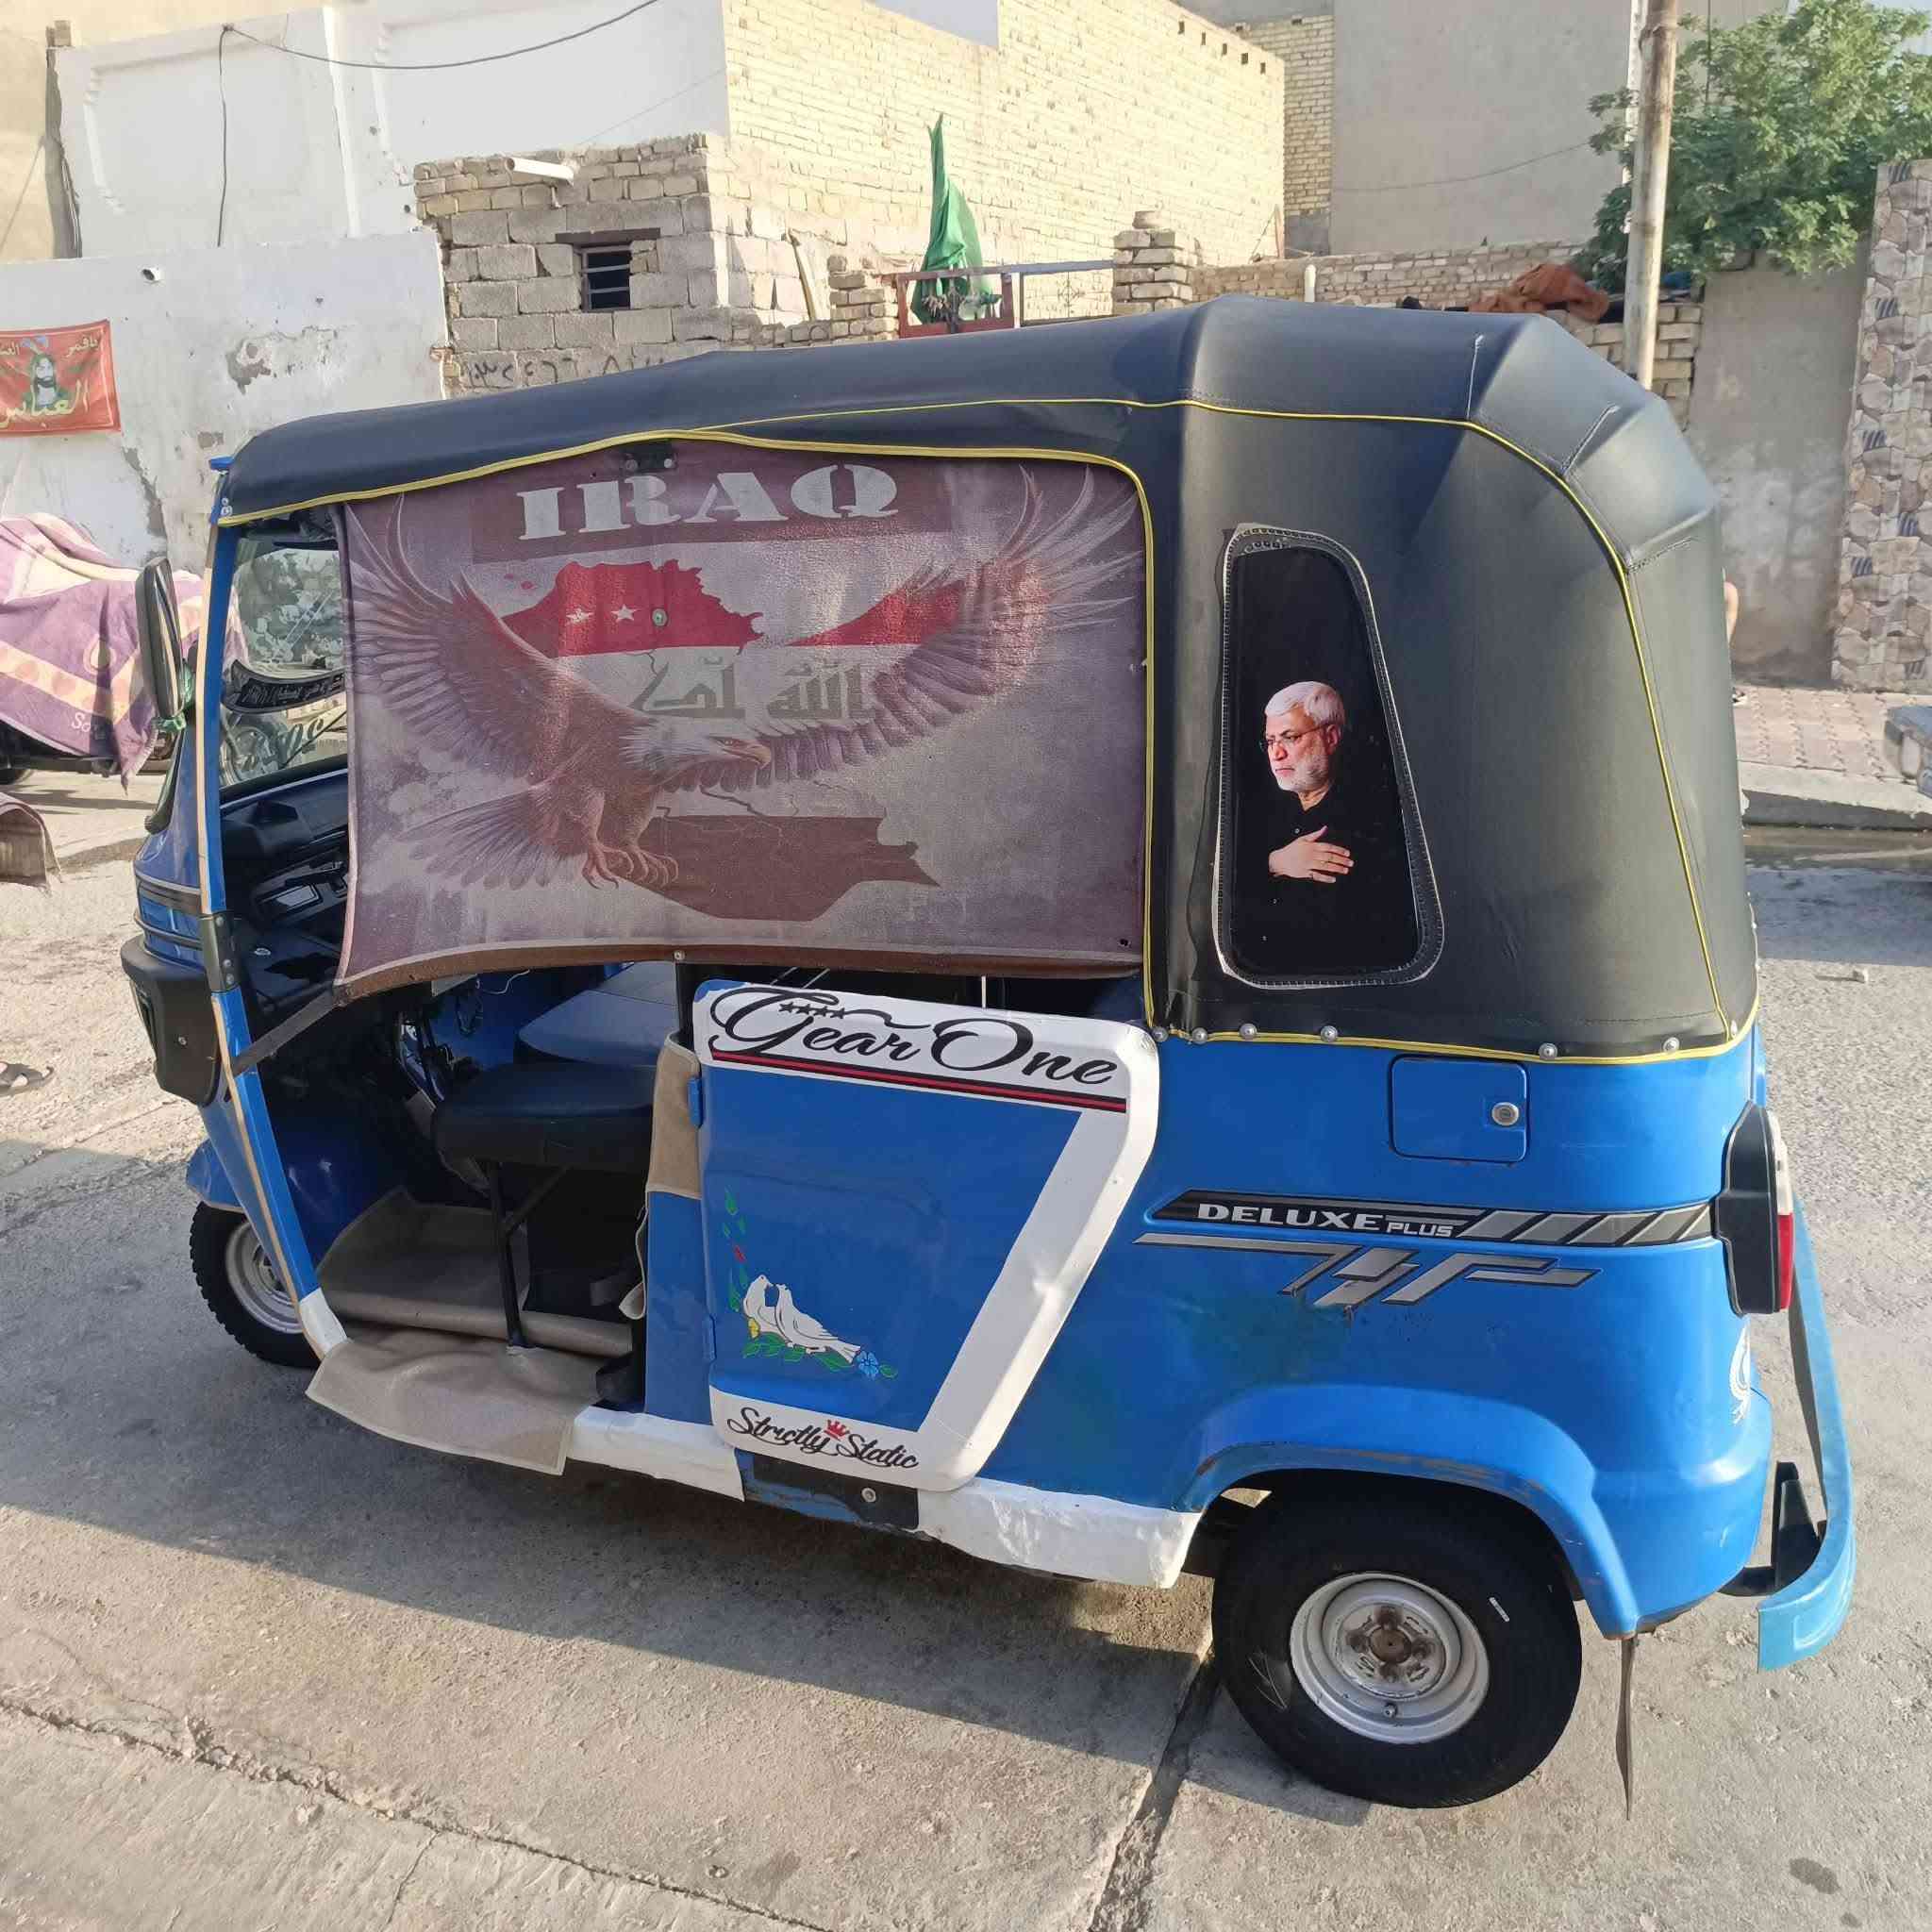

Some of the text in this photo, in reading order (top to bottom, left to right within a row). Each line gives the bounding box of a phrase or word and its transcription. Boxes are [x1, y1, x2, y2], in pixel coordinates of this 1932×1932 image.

[516, 465, 898, 541] IRAQ
[709, 988, 1119, 1084] Gear One
[1197, 1203, 1453, 1238] DELUXE PLUS
[727, 1407, 920, 1468] Strictly Static
